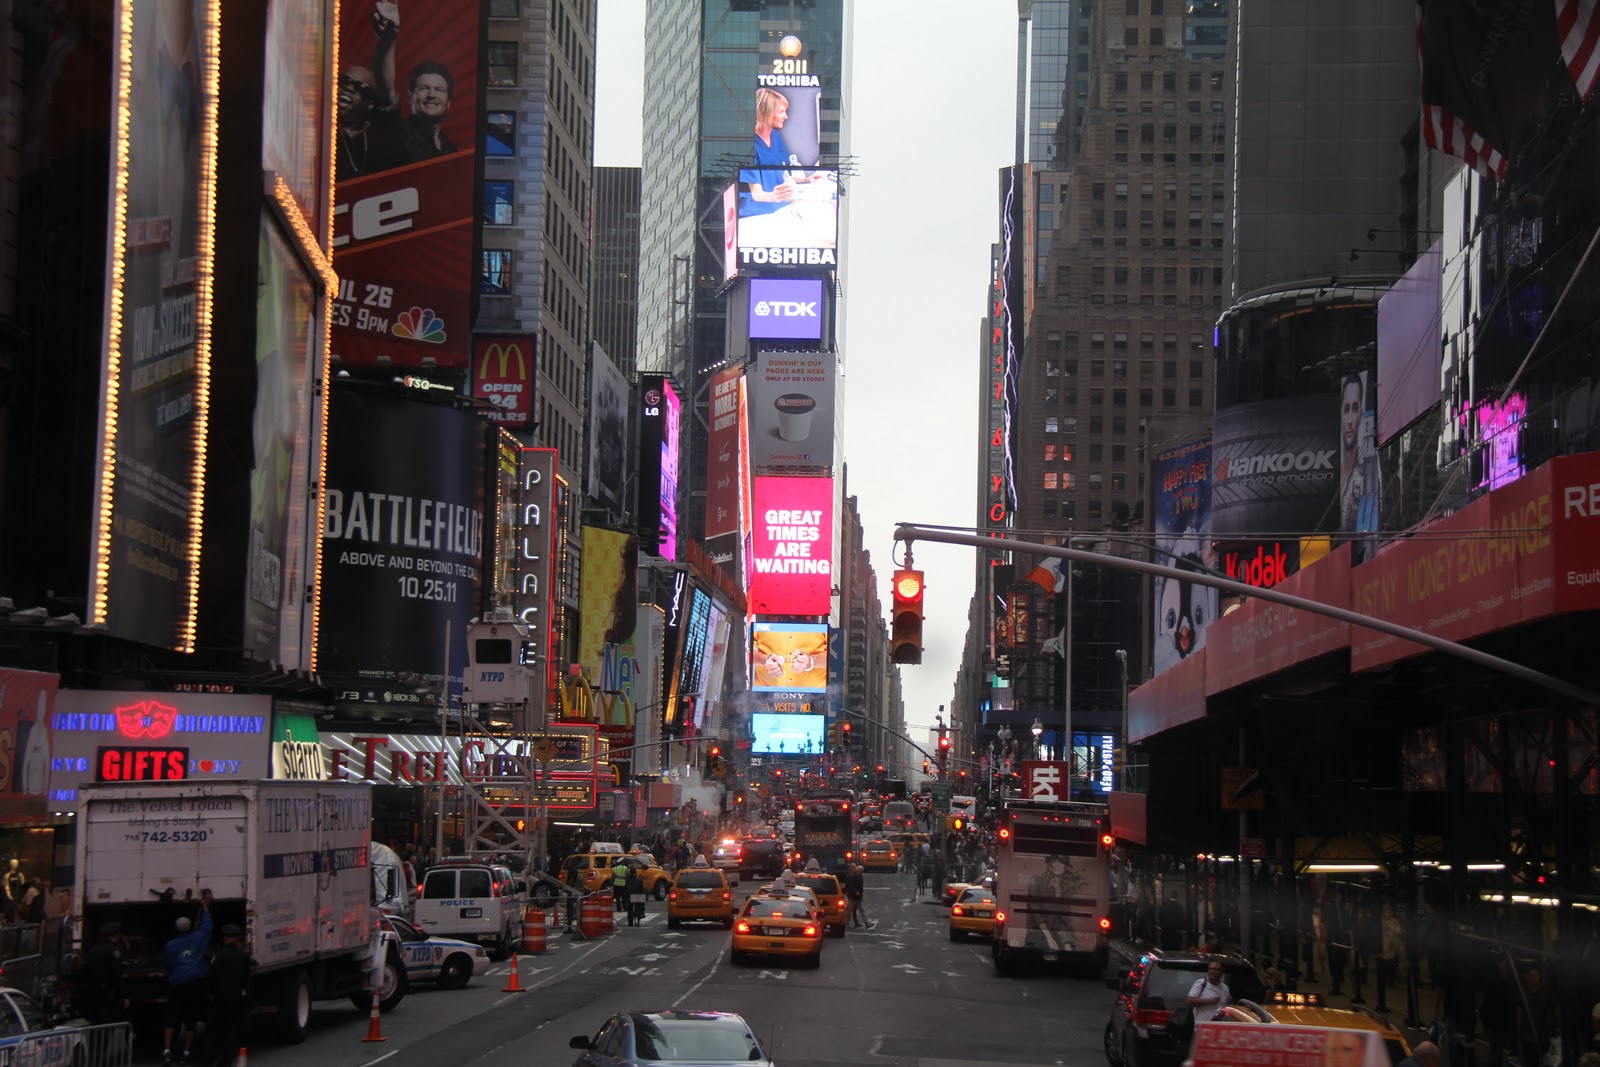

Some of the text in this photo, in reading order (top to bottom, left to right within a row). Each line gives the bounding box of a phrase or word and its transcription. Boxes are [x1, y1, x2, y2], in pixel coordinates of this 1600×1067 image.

[773, 60, 807, 74] 2011
[758, 75, 820, 87] TOSHIBA
[740, 247, 836, 265] TOSHIBA
[363, 284, 394, 309] 26
[769, 301, 817, 317] TDK
[356, 308, 389, 334] 9PM
[482, 383, 523, 393] OPEN
[489, 394, 518, 409] 24
[715, 391, 737, 417] MOBILE
[477, 411, 527, 421] OURS
[645, 408, 659, 416] LG
[1163, 467, 1188, 492] HAPPY
[1239, 471, 1334, 487] driving emotion
[323, 489, 478, 556] BATTLEFIELD
[765, 510, 822, 525] GREAT
[766, 526, 820, 541] TIMES
[775, 542, 811, 557] ARE
[1407, 549, 1451, 603] MONEY
[1458, 492, 1553, 583] EXCHANGE
[339, 551, 386, 568] ABOVE
[388, 556, 414, 570] AND
[416, 558, 453, 575] BEYOND
[454, 563, 467, 578] THE
[519, 469, 542, 664] PALACE
[755, 558, 830, 574] WAITING
[1225, 542, 1288, 588] Kodak
[398, 576, 457, 603] 10.25.11
[480, 671, 505, 682] NYPD
[339, 691, 360, 700] S3
[774, 702, 797, 712] VISITS
[175, 713, 264, 733] BROADWAY
[282, 729, 321, 780] sbarro
[352, 737, 449, 782] TREE
[52, 757, 90, 772] NYC
[101, 750, 186, 781] GIFTS
[213, 760, 242, 773] NY
[1033, 765, 1060, 800] tkt
[108, 797, 233, 813] The Velvet Touch
[128, 817, 160, 828] Moving
[173, 816, 207, 827] Storage
[266, 798, 291, 834] THE
[141, 830, 208, 843] 742-5320
[283, 853, 314, 876] MOVING
[440, 899, 475, 907] POLICE
